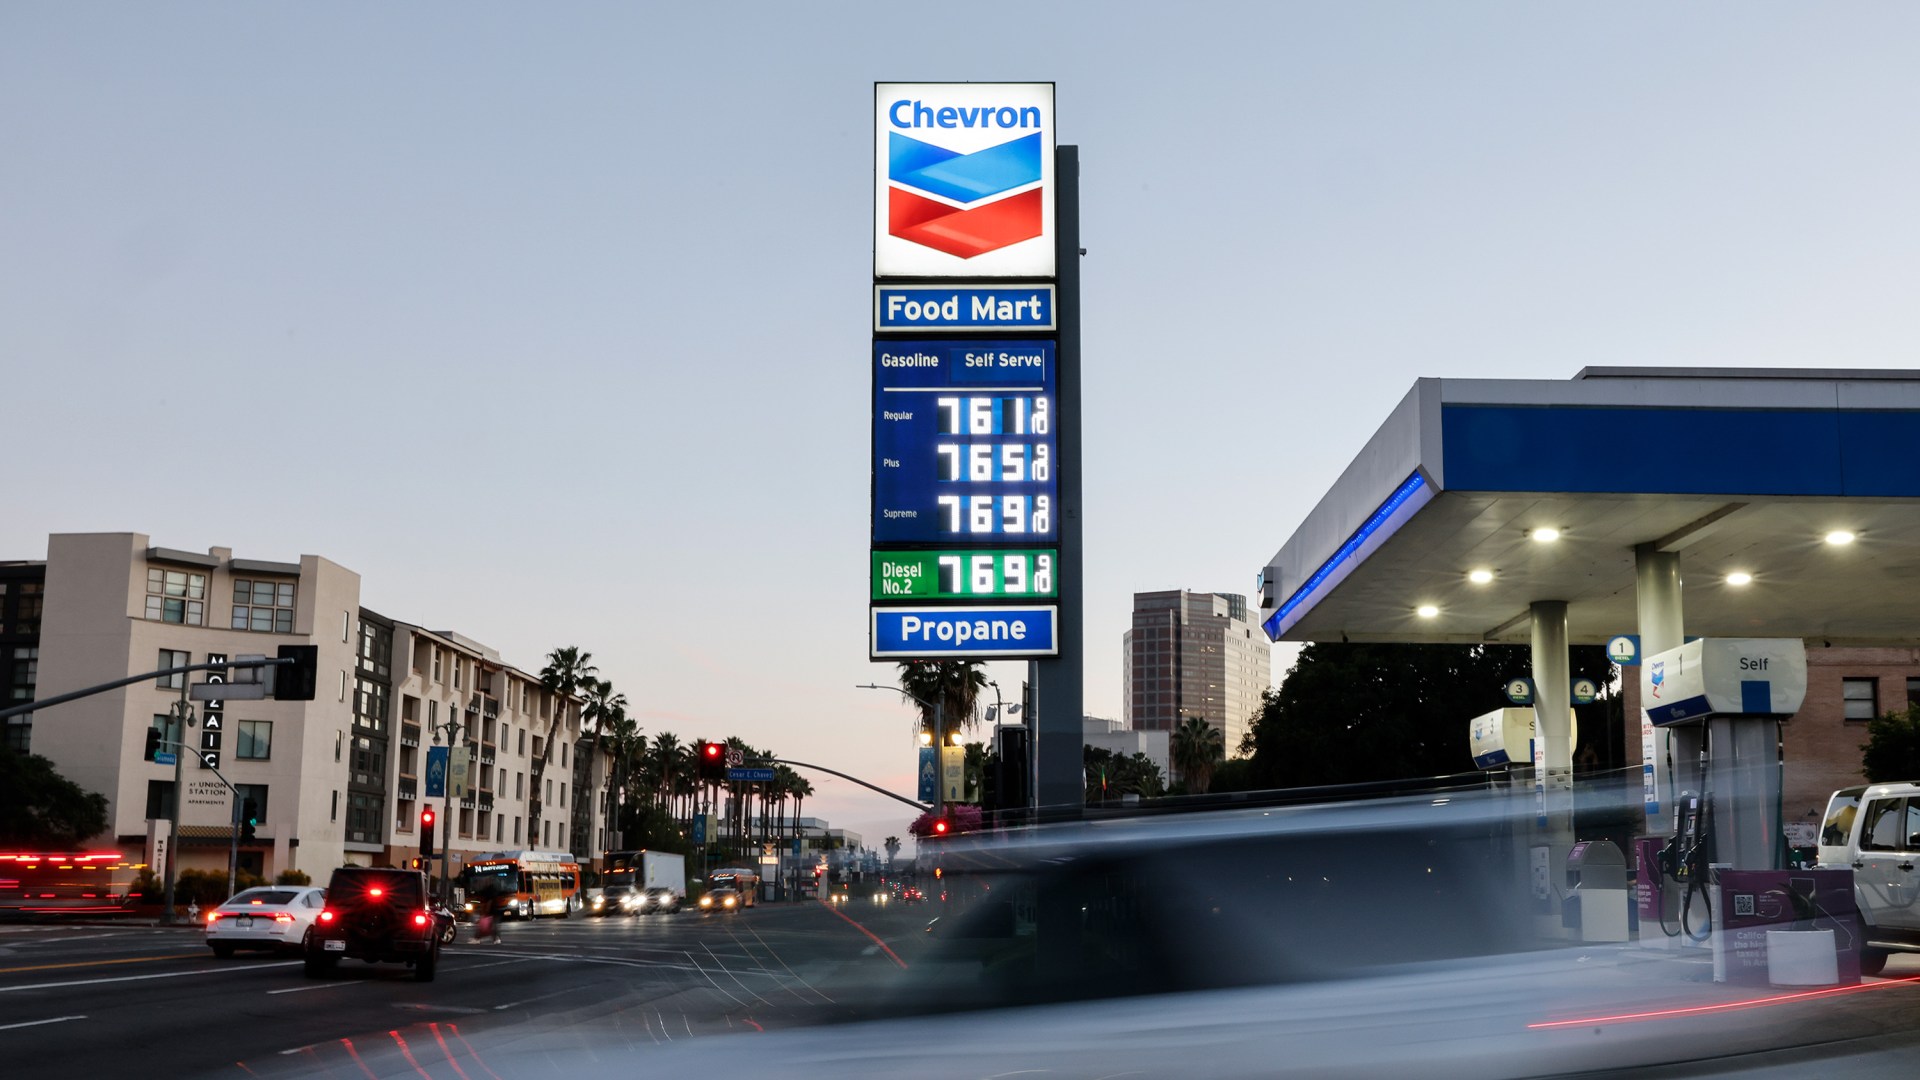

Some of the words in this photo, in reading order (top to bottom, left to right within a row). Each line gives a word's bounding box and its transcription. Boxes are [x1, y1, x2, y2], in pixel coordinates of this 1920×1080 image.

[889, 99, 1041, 129] Chevron
[888, 295, 959, 321] Food
[971, 295, 1042, 321] Mart
[881, 353, 939, 368] Gasoline
[965, 353, 994, 368] Self
[999, 353, 1042, 368] Serve
[883, 411, 913, 422] Regular
[938, 397, 1024, 435] 761
[883, 458, 900, 468] Plus
[938, 444, 1024, 481] 765
[883, 509, 918, 520] Supreme
[938, 495, 1025, 533] 769
[882, 562, 922, 577] Diesel
[939, 555, 1026, 593] 769
[882, 579, 913, 594] No.2
[901, 616, 1027, 647] Propane
[1619, 642, 1624, 654] 1
[1678, 653, 1683, 675] 1
[1740, 657, 1768, 671] Self
[1515, 684, 1523, 694] 3
[1580, 684, 1588, 694] 4
[753, 771, 772, 779] Chavez
[188, 788, 226, 796] STATION
[1736, 931, 1766, 940] Califor
